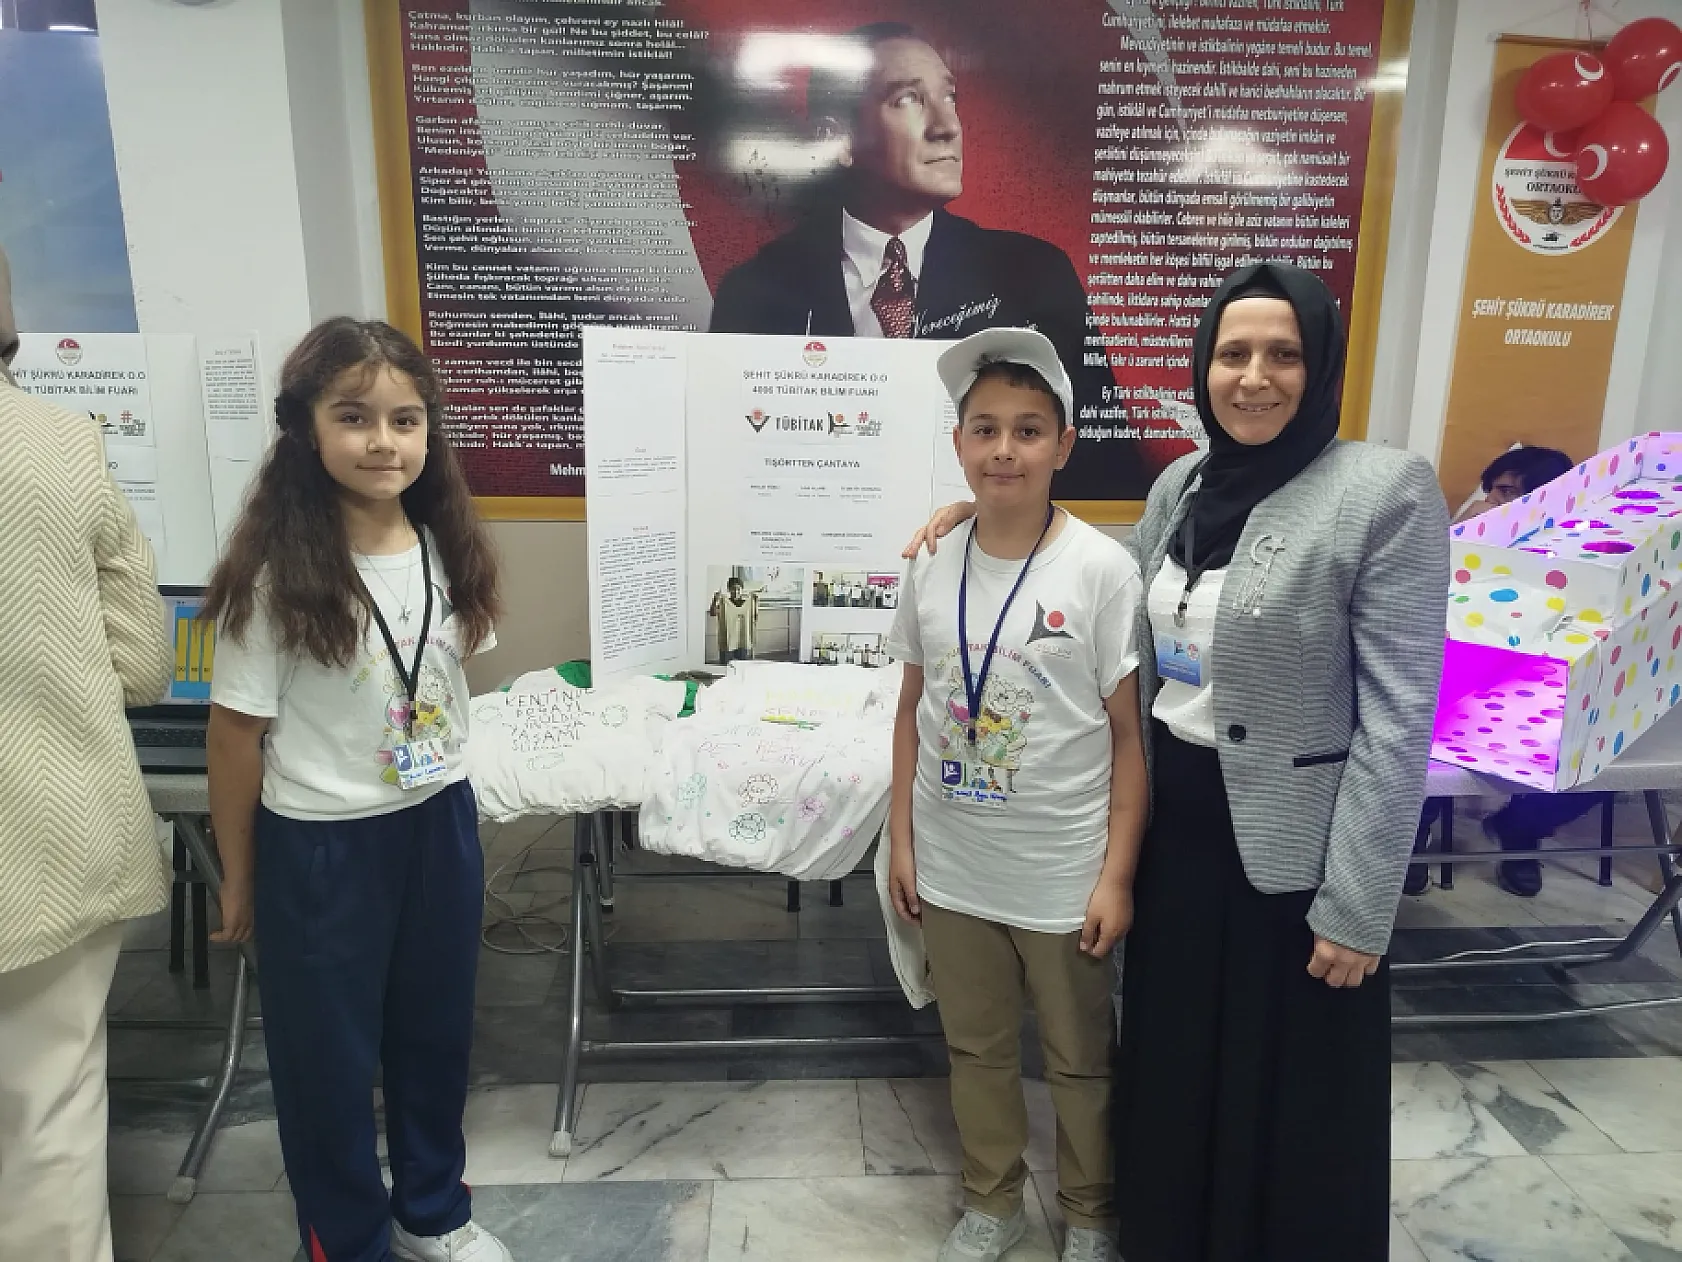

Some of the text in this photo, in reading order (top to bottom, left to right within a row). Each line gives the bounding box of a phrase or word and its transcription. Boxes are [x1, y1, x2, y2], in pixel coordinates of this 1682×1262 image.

[1525, 181, 1582, 195] ORTAOK
[1471, 296, 1615, 321] ŞEHİT ŞÜKRÜ KARADİREK
[1504, 328, 1572, 348] ORTAOKULU
[743, 369, 772, 381] ŞEHİT
[35, 385, 76, 395] TÜBİTAK
[108, 386, 138, 396] FUARI
[776, 384, 818, 396] TÜBİTAK
[820, 385, 846, 397] BİLİM
[775, 415, 824, 432] TÜBİTAK
[550, 463, 585, 477] Mehm
[816, 458, 860, 469] ÇANTAYA
